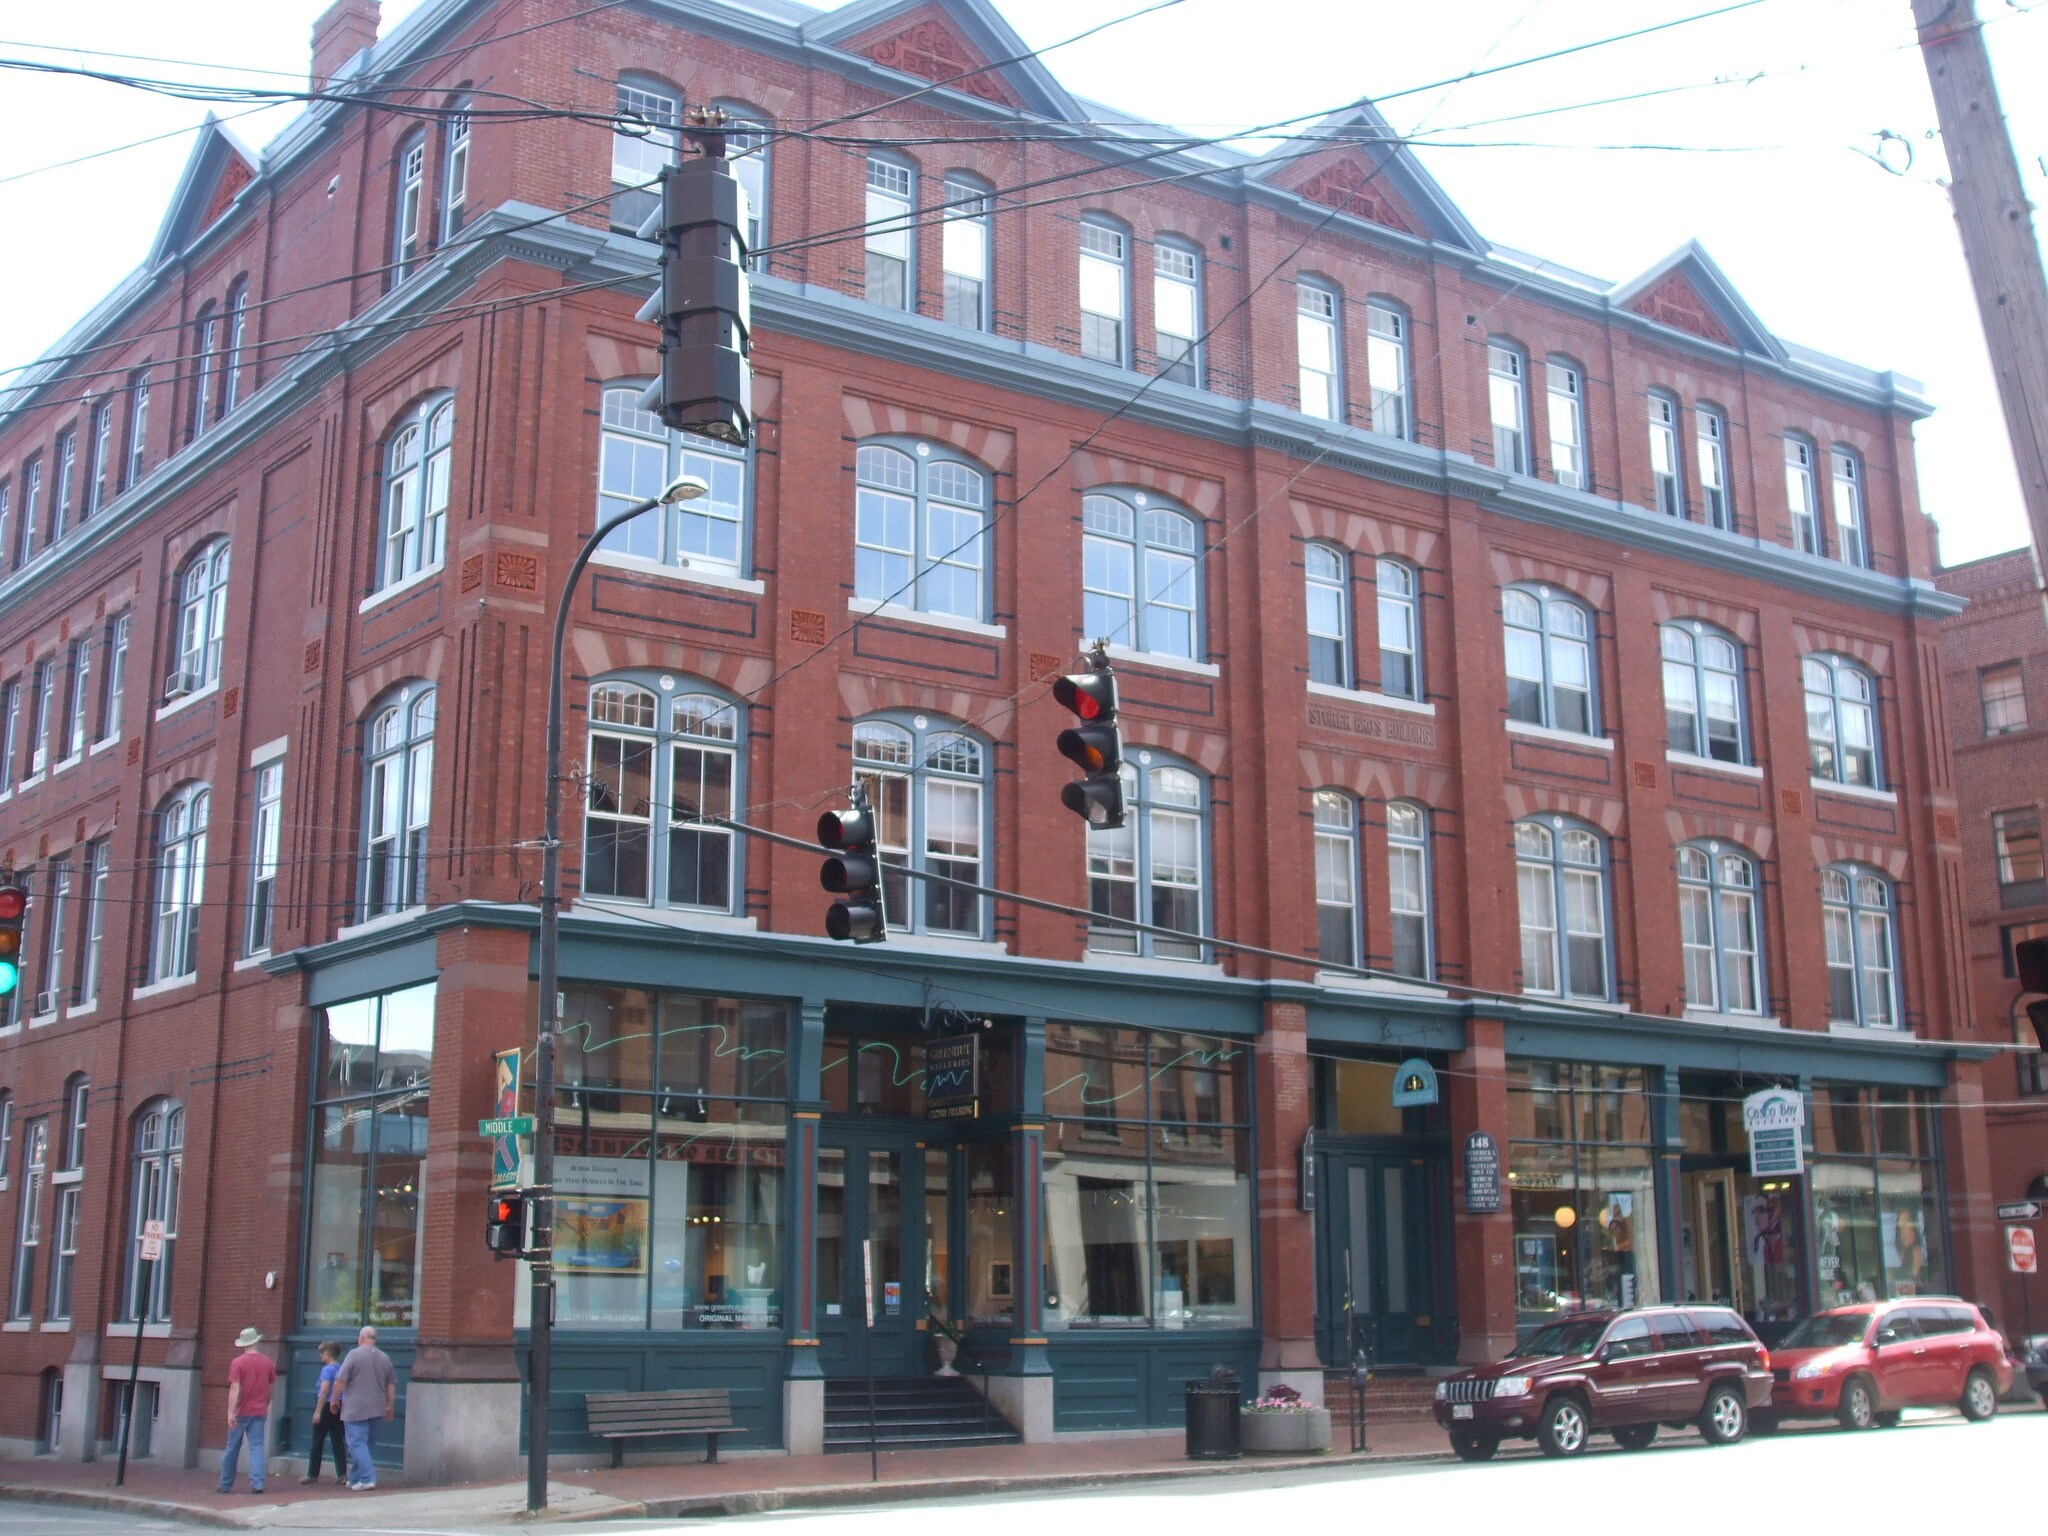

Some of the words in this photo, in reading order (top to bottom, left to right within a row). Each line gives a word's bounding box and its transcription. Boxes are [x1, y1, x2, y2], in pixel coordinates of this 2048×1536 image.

[1309, 708, 1351, 730] STORER
[485, 1121, 513, 1135] MIDDLE
[1470, 1136, 1489, 1149] 148
[1820, 1257, 1840, 1268] NEVER
[699, 1314, 734, 1323] ORIGINAL
